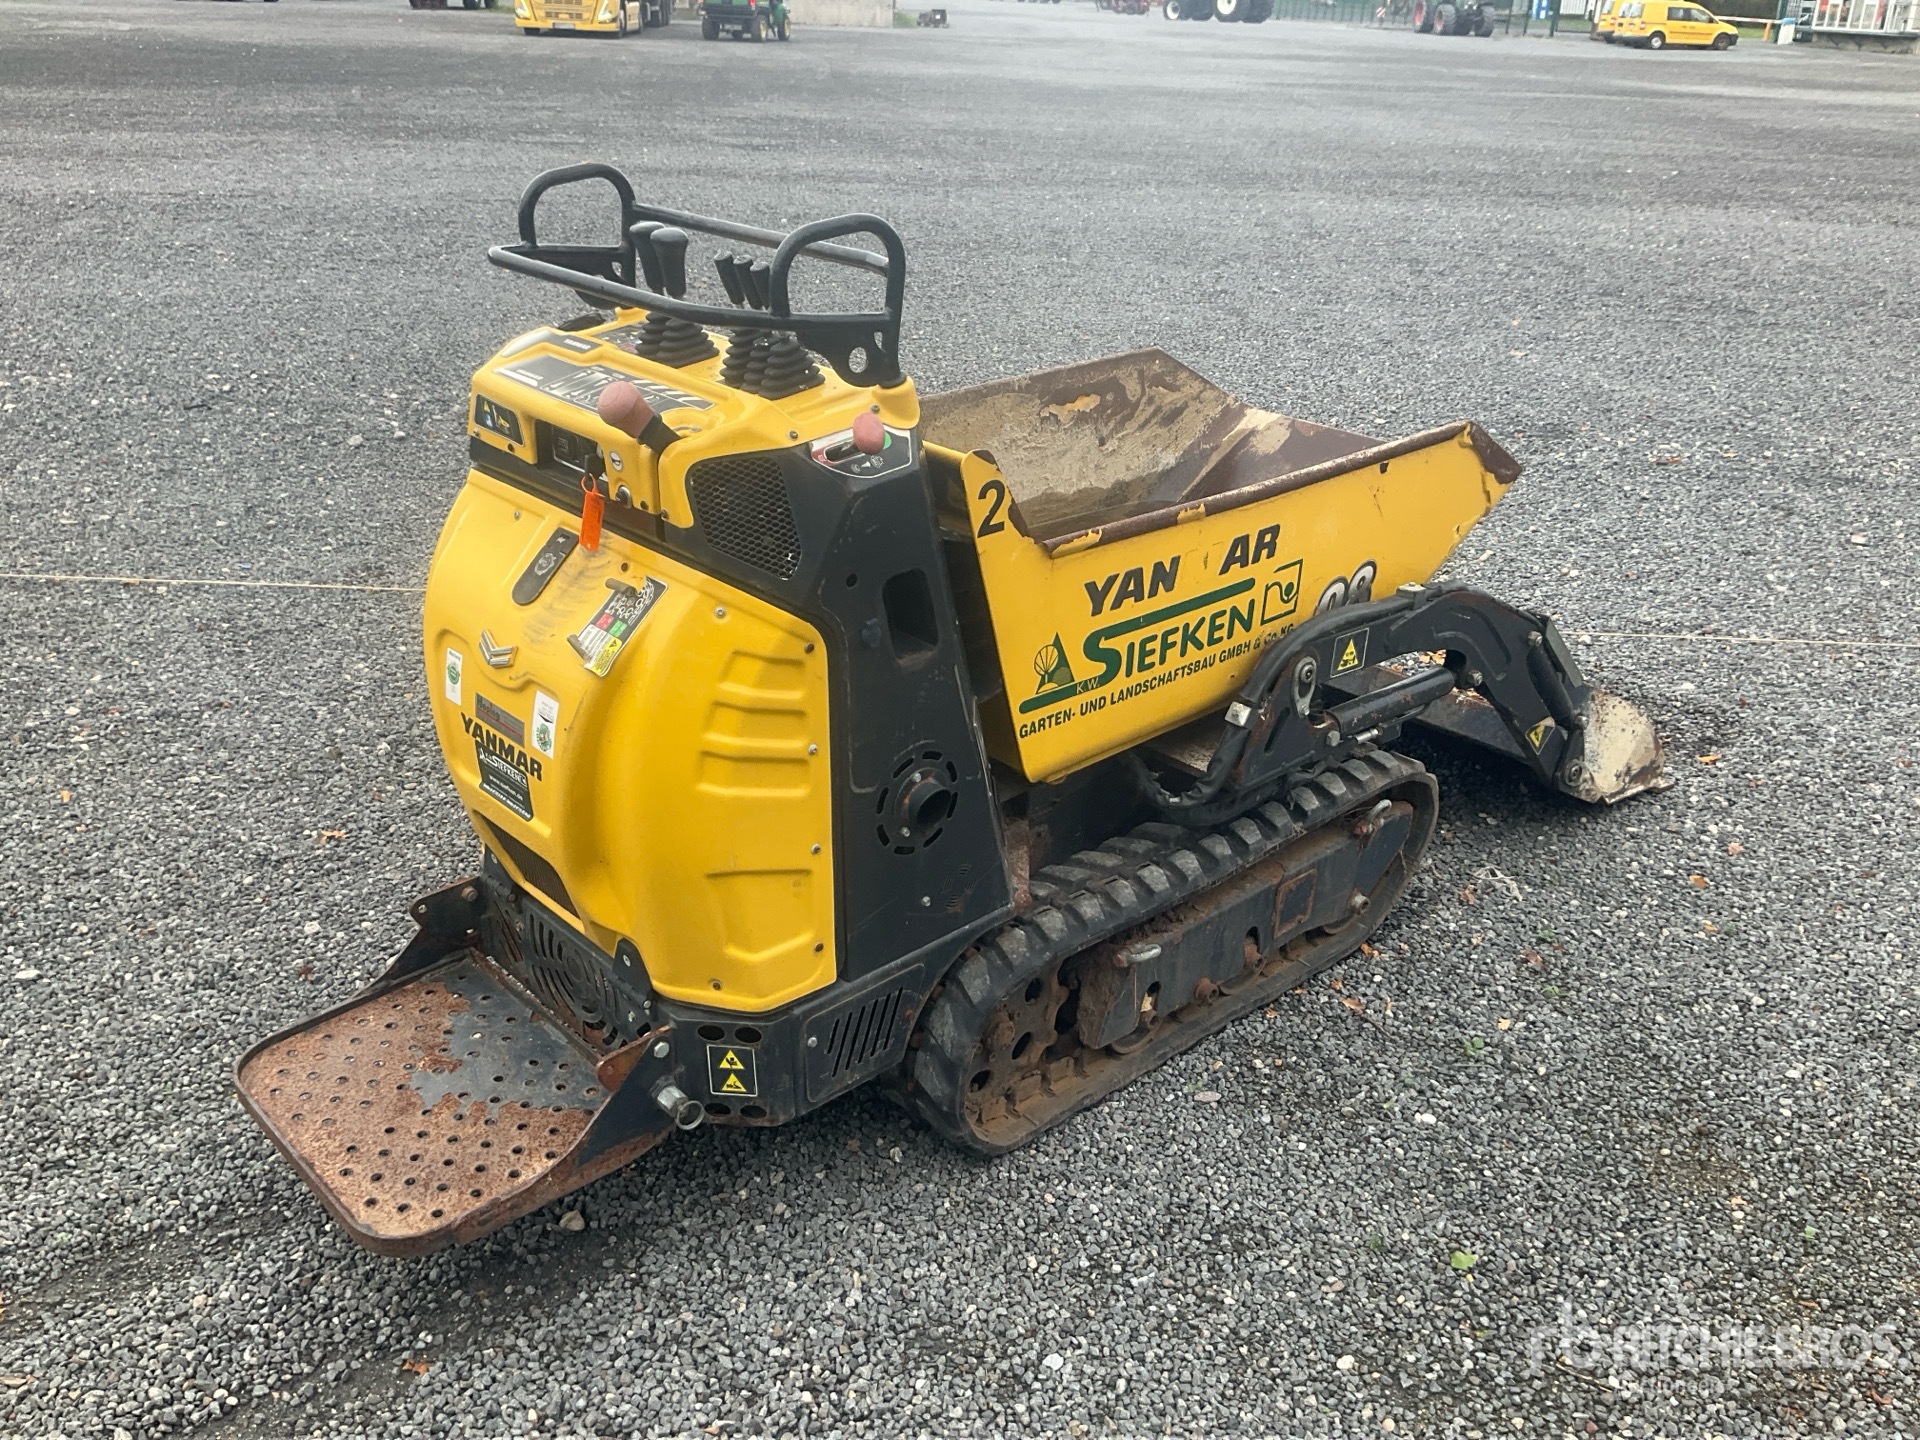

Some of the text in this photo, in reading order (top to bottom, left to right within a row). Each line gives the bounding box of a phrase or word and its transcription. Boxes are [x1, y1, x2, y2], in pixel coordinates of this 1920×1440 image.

[977, 479, 1005, 538] 2
[1083, 598, 1255, 690] SIEFKEN
[1018, 707, 1076, 739] GARTEN-
[1080, 695, 1107, 716] UND
[1110, 654, 1216, 706] LANDSCHAFTSBAU
[1218, 639, 1251, 663] GMBH
[1075, 676, 1101, 695] K.W.
[460, 711, 543, 782] YANMAR
